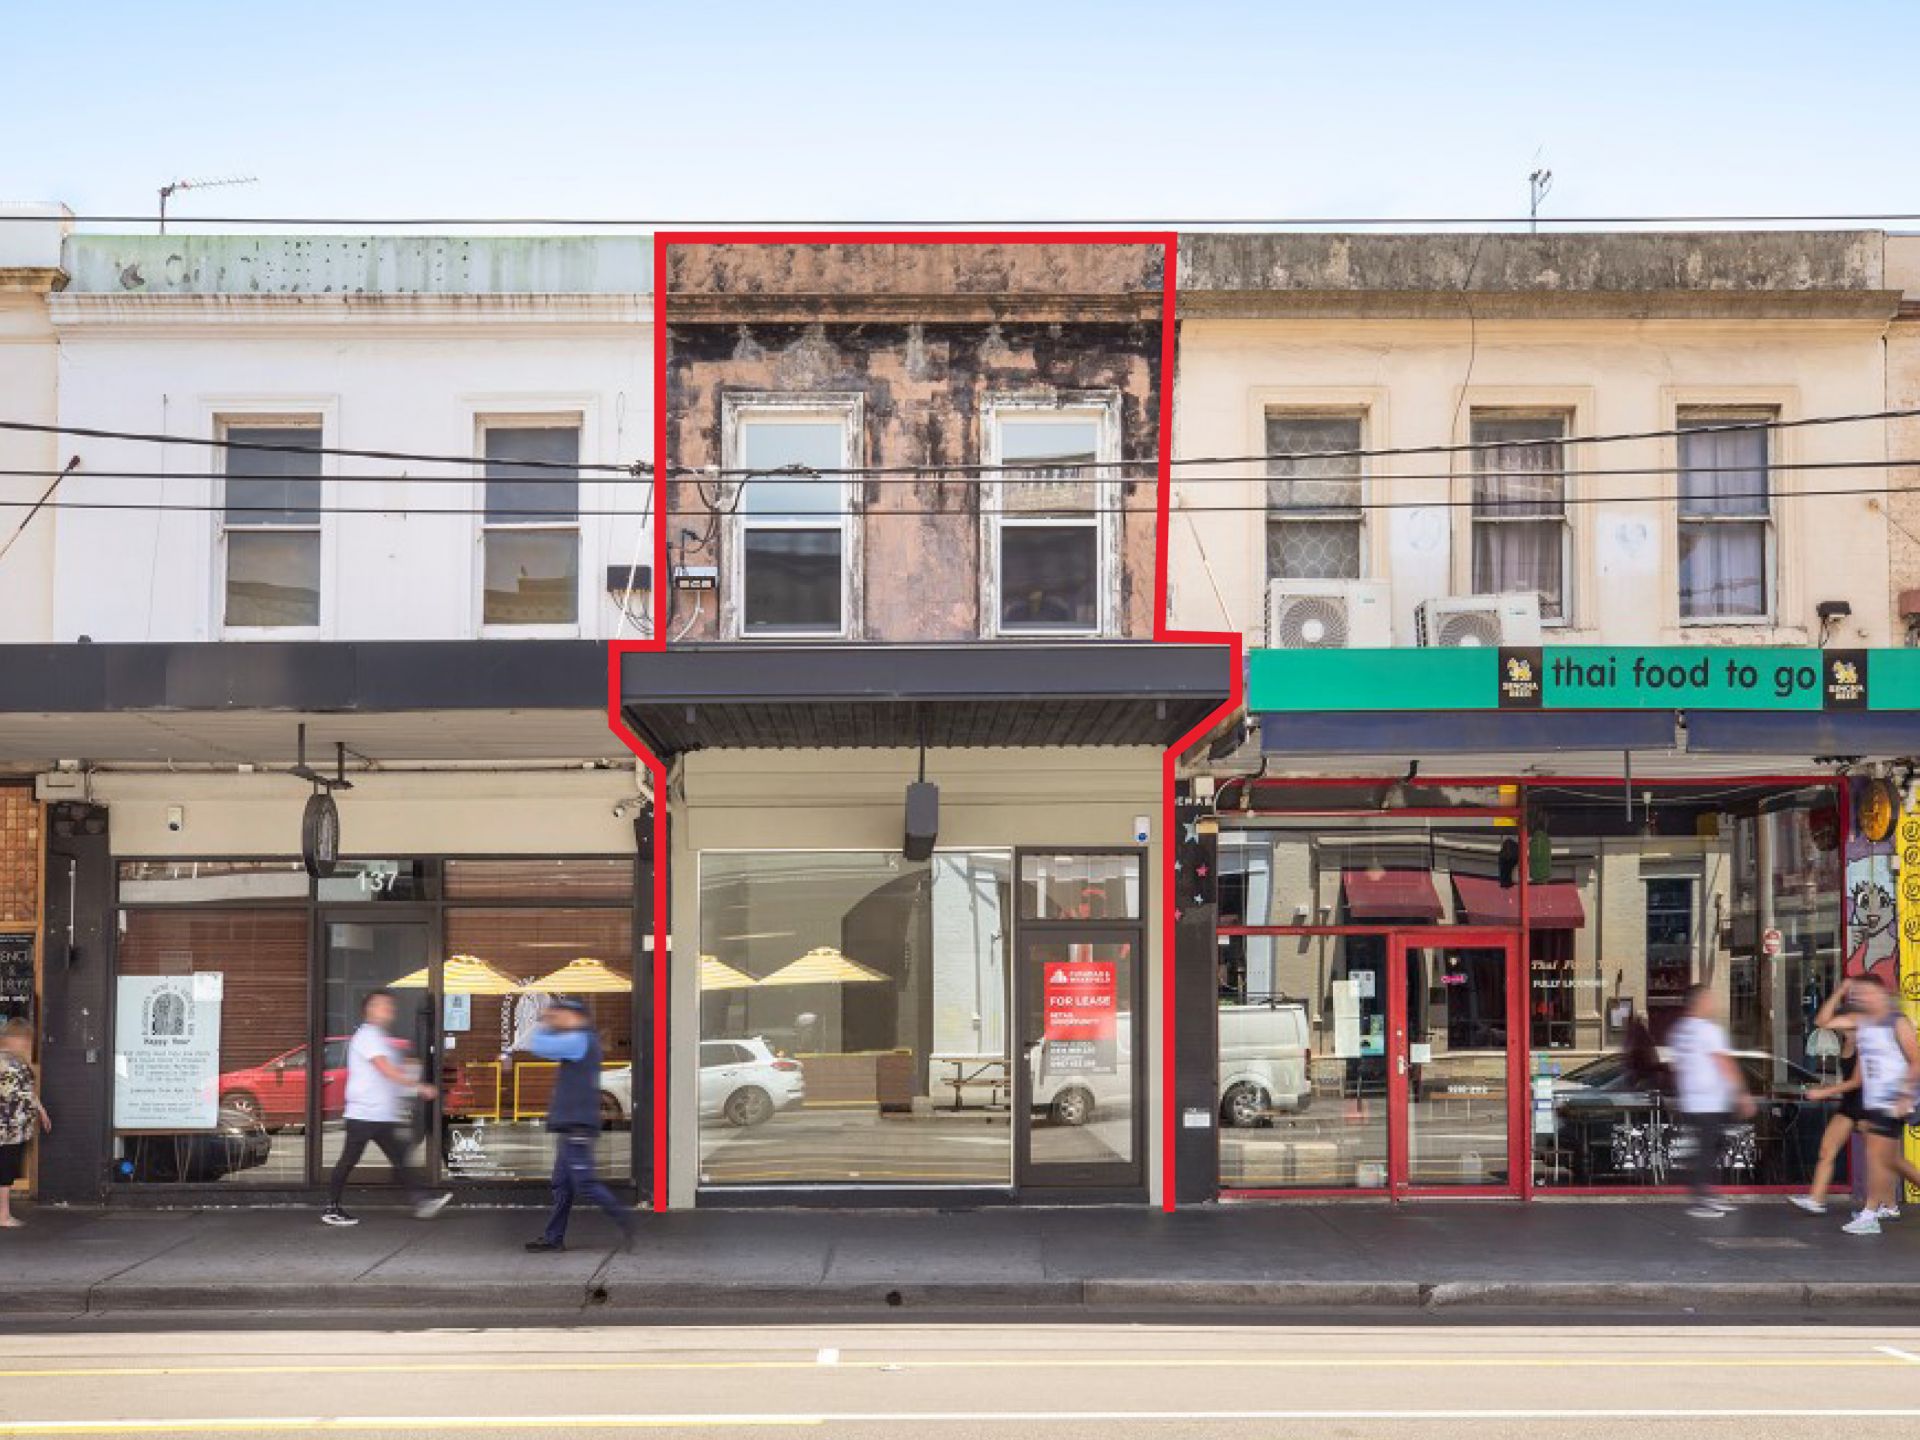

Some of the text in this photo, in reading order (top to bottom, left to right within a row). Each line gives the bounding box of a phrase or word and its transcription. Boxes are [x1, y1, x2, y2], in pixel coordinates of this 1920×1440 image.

[1551, 656, 1817, 697] thai food to go
[354, 870, 398, 892] 137
[1050, 996, 1111, 1007] FOR LEASE
